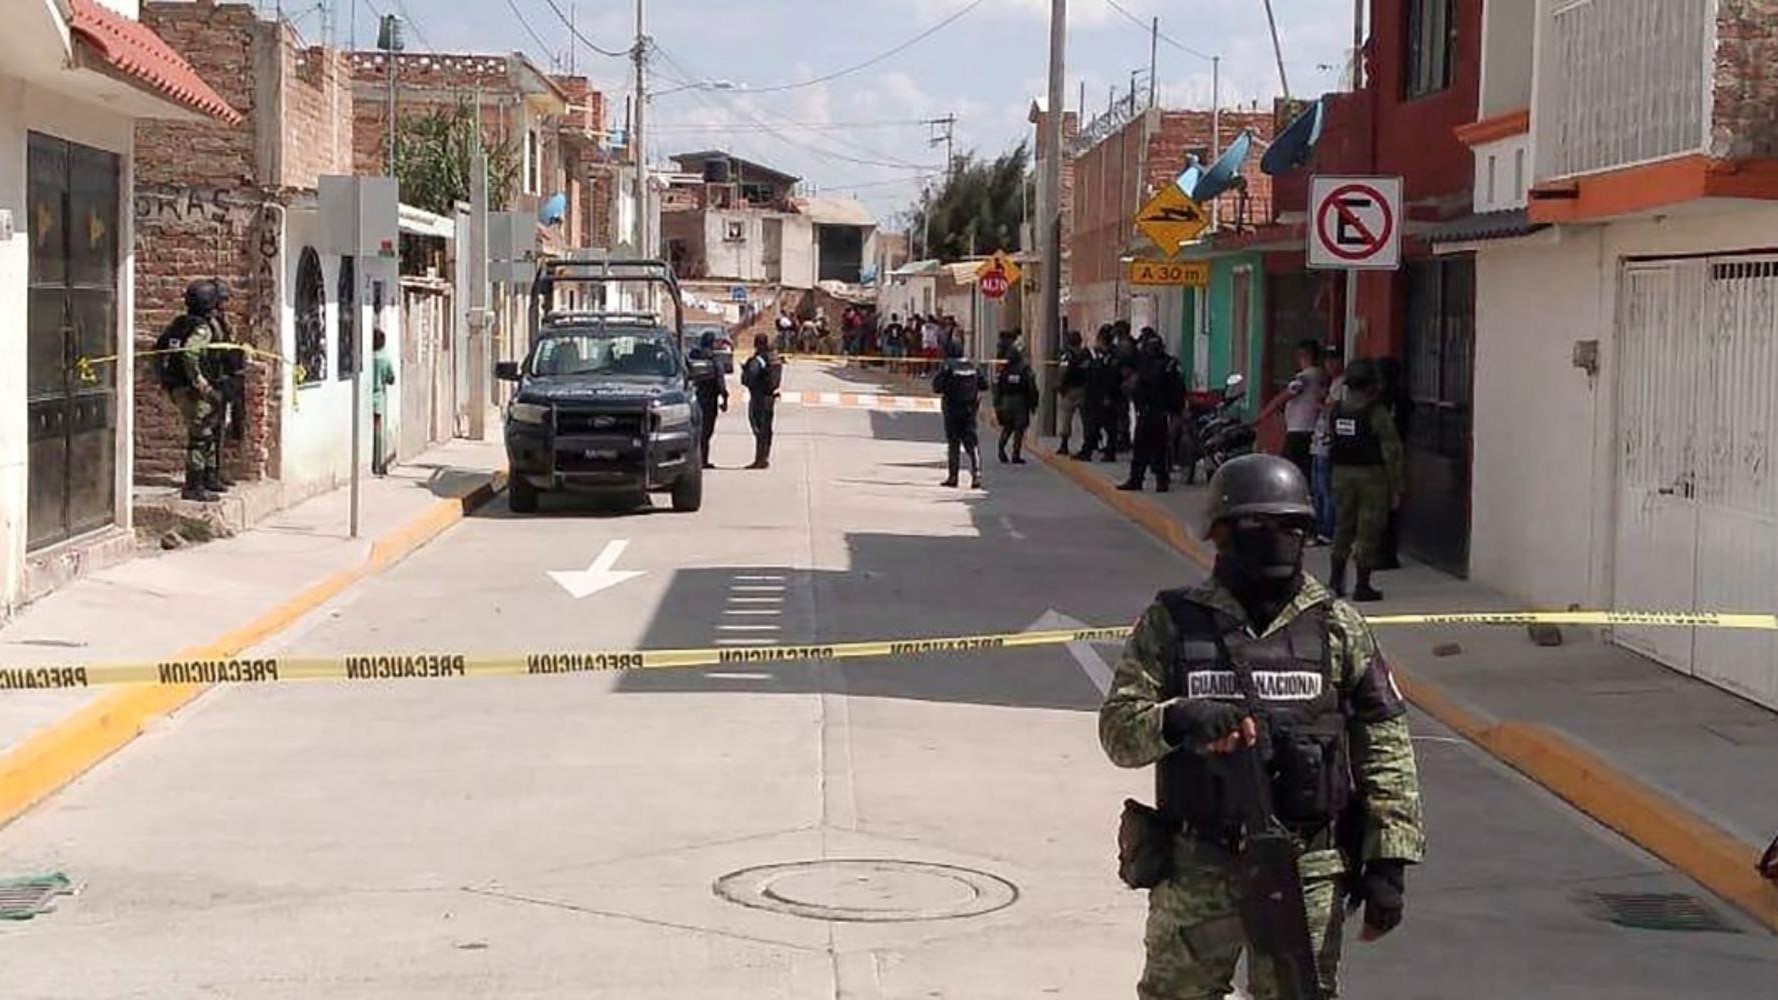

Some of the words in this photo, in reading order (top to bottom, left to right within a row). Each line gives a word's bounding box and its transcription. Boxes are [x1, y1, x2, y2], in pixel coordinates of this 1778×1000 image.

[1142, 266, 1153, 279] A
[1158, 266, 1181, 280] 30
[1185, 270, 1200, 281] m
[981, 278, 1009, 290] ALTO
